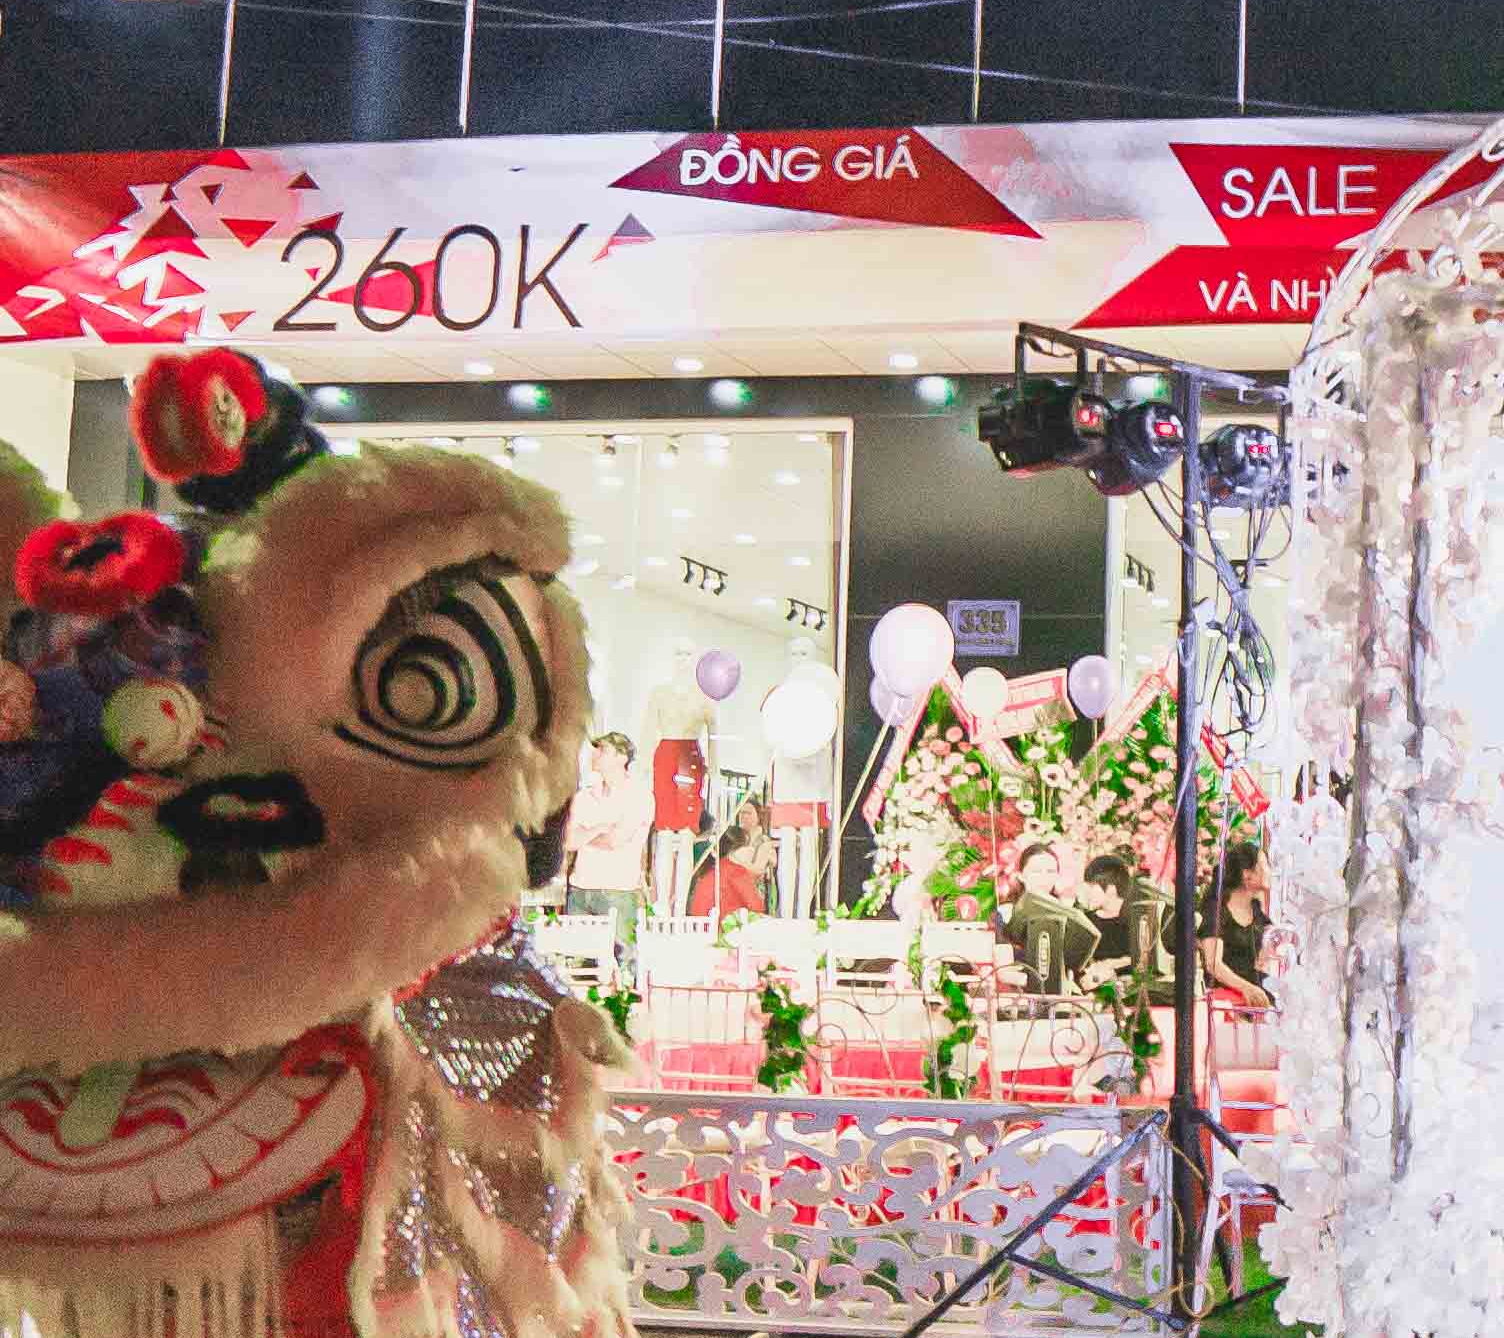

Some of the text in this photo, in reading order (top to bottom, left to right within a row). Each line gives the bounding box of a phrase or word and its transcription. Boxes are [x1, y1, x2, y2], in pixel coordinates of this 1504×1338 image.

[679, 133, 921, 186] ĐỒNG GIÁ
[1220, 164, 1377, 220] SALE
[272, 222, 590, 333] 260K
[1198, 271, 1259, 313] VÀ
